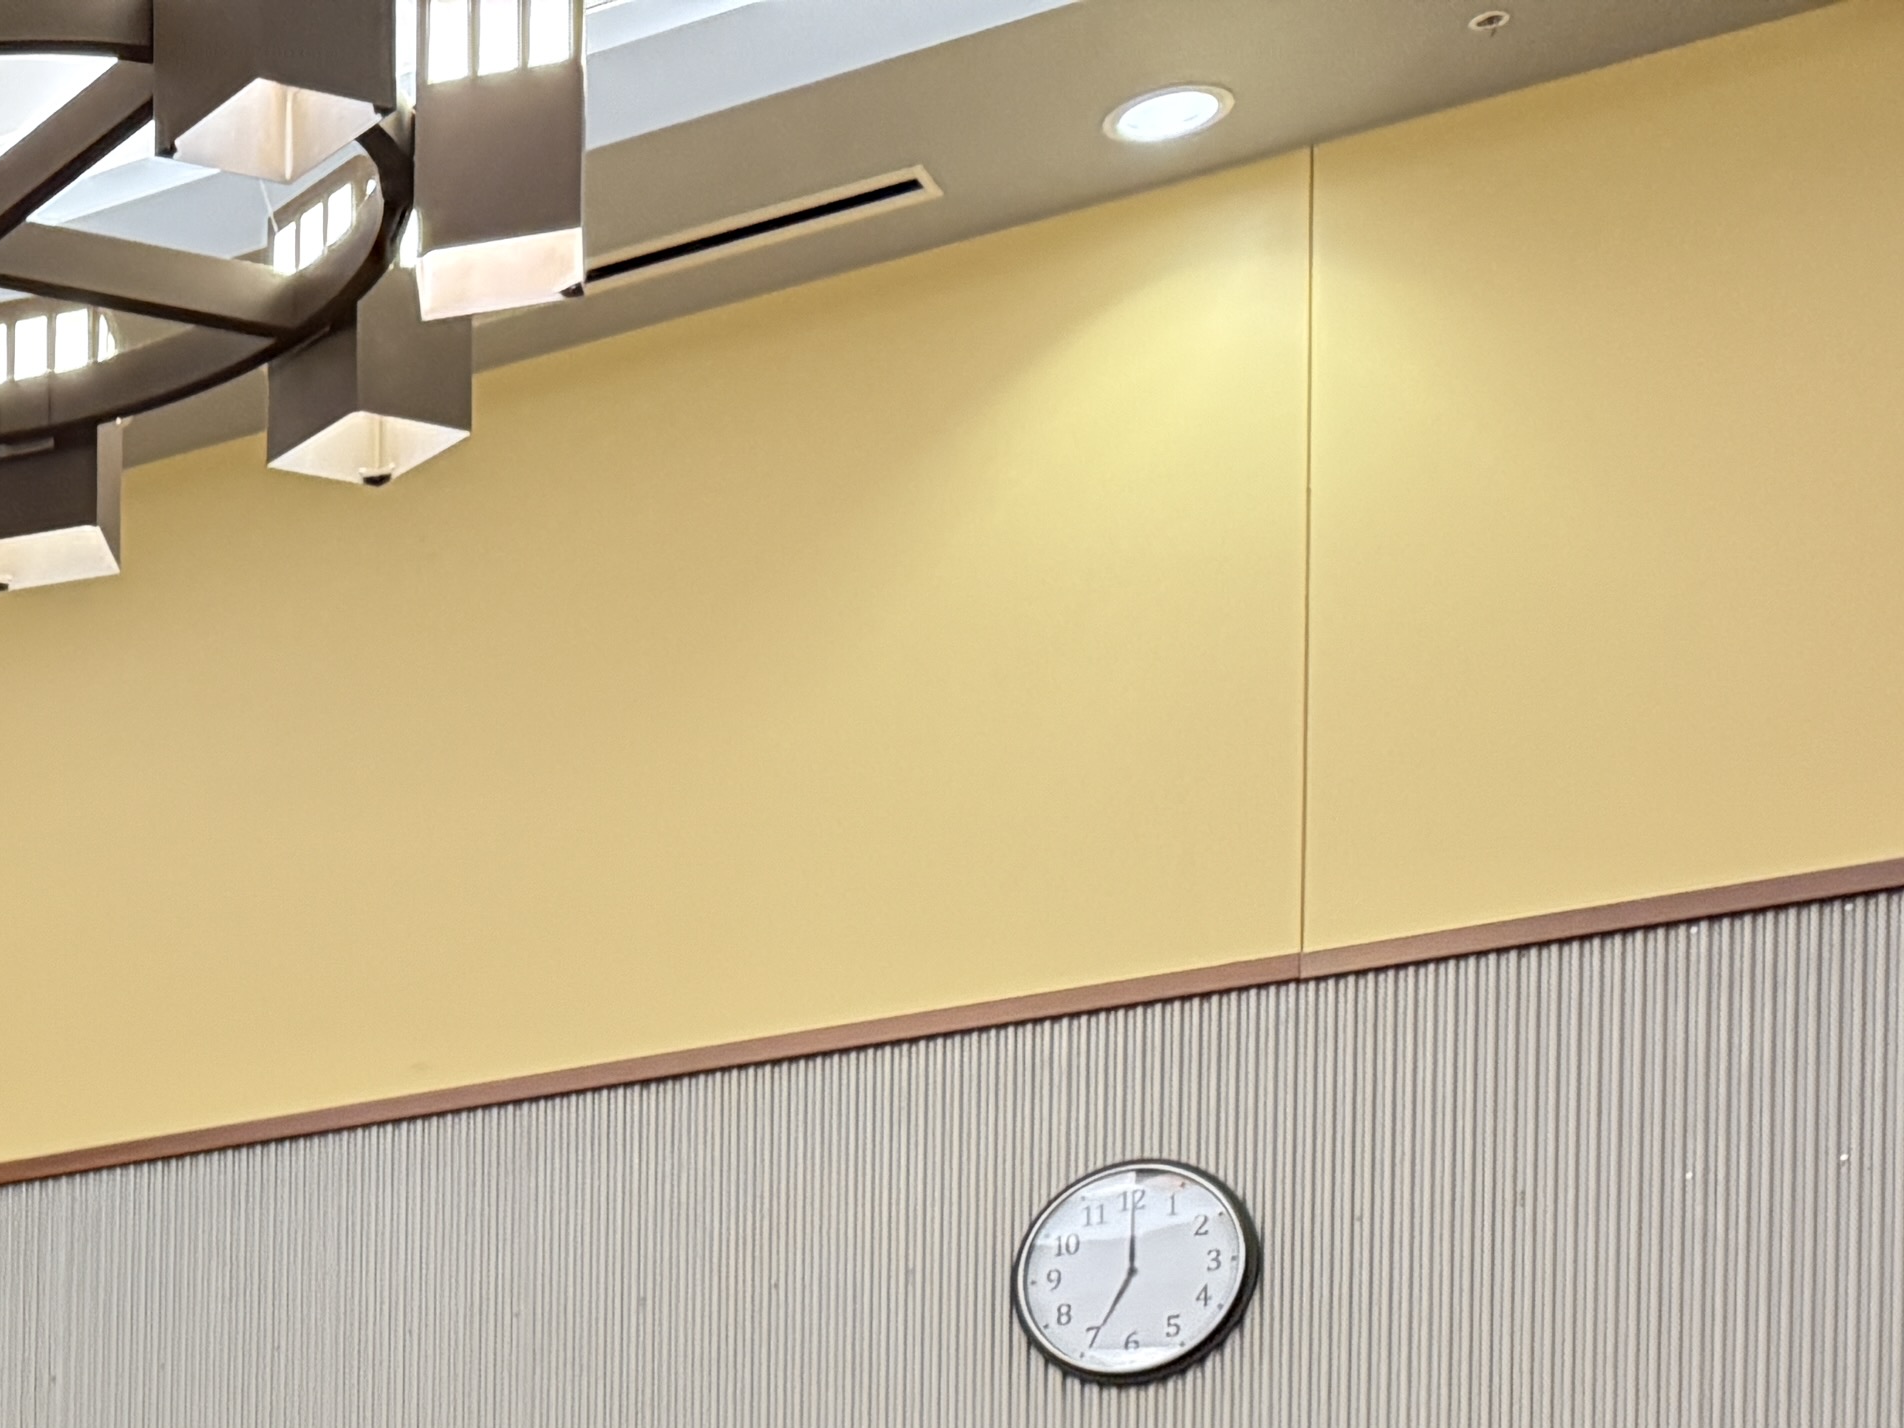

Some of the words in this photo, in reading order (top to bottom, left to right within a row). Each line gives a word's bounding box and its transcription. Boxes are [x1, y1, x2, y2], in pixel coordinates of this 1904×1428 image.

[1119, 1189, 1147, 1212] 12
[1169, 1193, 1177, 1216] 1
[1082, 1204, 1105, 1227] 11
[1194, 1214, 1209, 1236] 2
[1055, 1233, 1080, 1257] 10
[1207, 1249, 1221, 1271] 3
[1046, 1269, 1061, 1290] 9
[1195, 1283, 1212, 1307] 4
[1057, 1304, 1072, 1326] 8
[1165, 1314, 1180, 1338] 5
[1086, 1326, 1103, 1348] 7
[1124, 1331, 1140, 1350] 6
